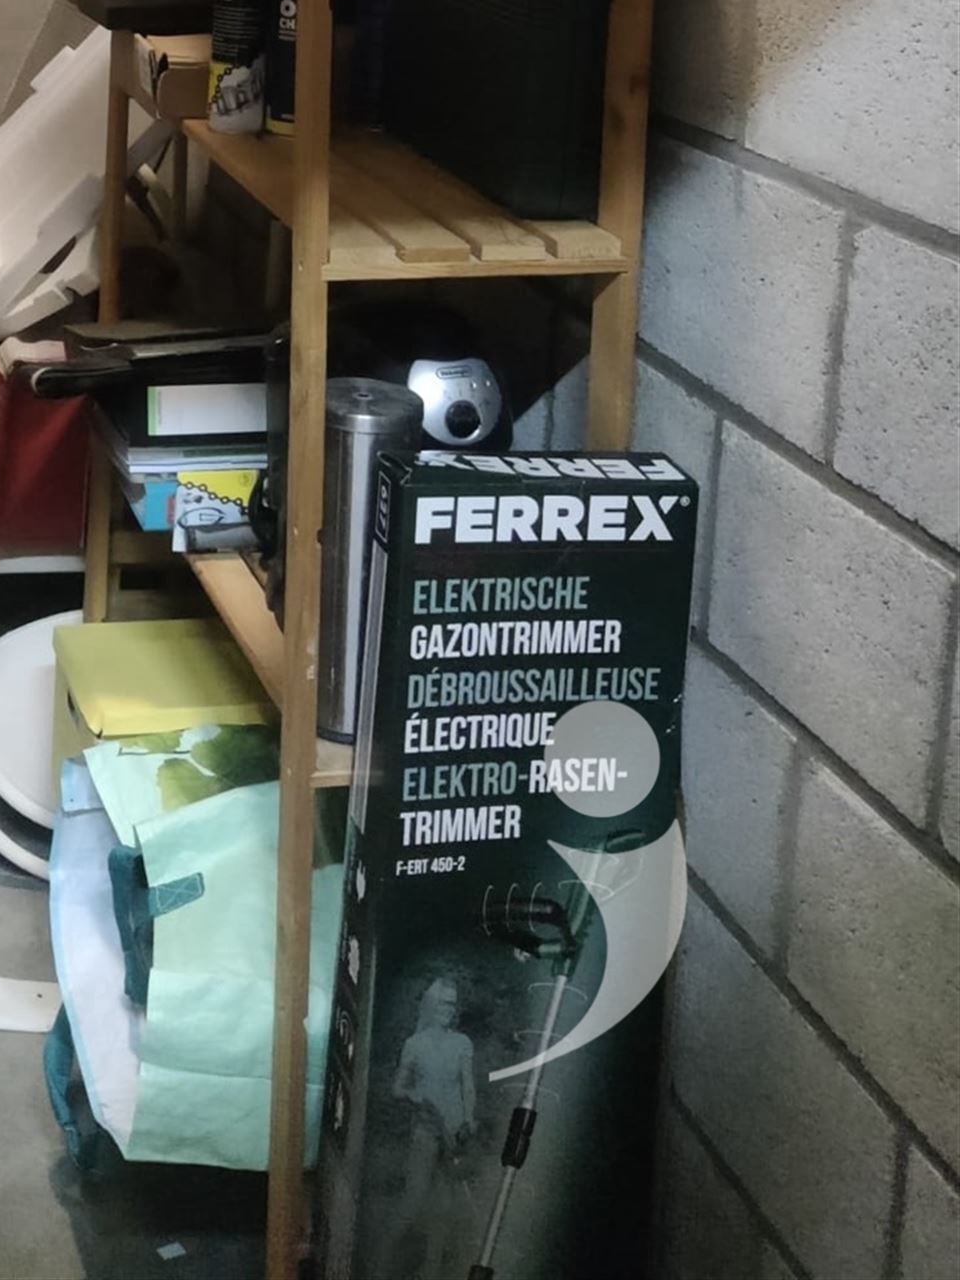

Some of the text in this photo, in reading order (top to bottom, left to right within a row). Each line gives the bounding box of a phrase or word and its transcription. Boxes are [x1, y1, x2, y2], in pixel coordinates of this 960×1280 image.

[414, 494, 679, 544] FERREX
[413, 576, 590, 615] ELEKTRISCHE
[409, 619, 622, 660] GAZONTRIMMER
[407, 666, 661, 709] DÉBROUSSAILLEUSE
[404, 711, 557, 754] ÉLECTRIQUE
[402, 757, 628, 802] ELEKTRO-RASEN-
[400, 804, 521, 846] TRIMMER
[395, 856, 466, 876] F-ERT 450-2
